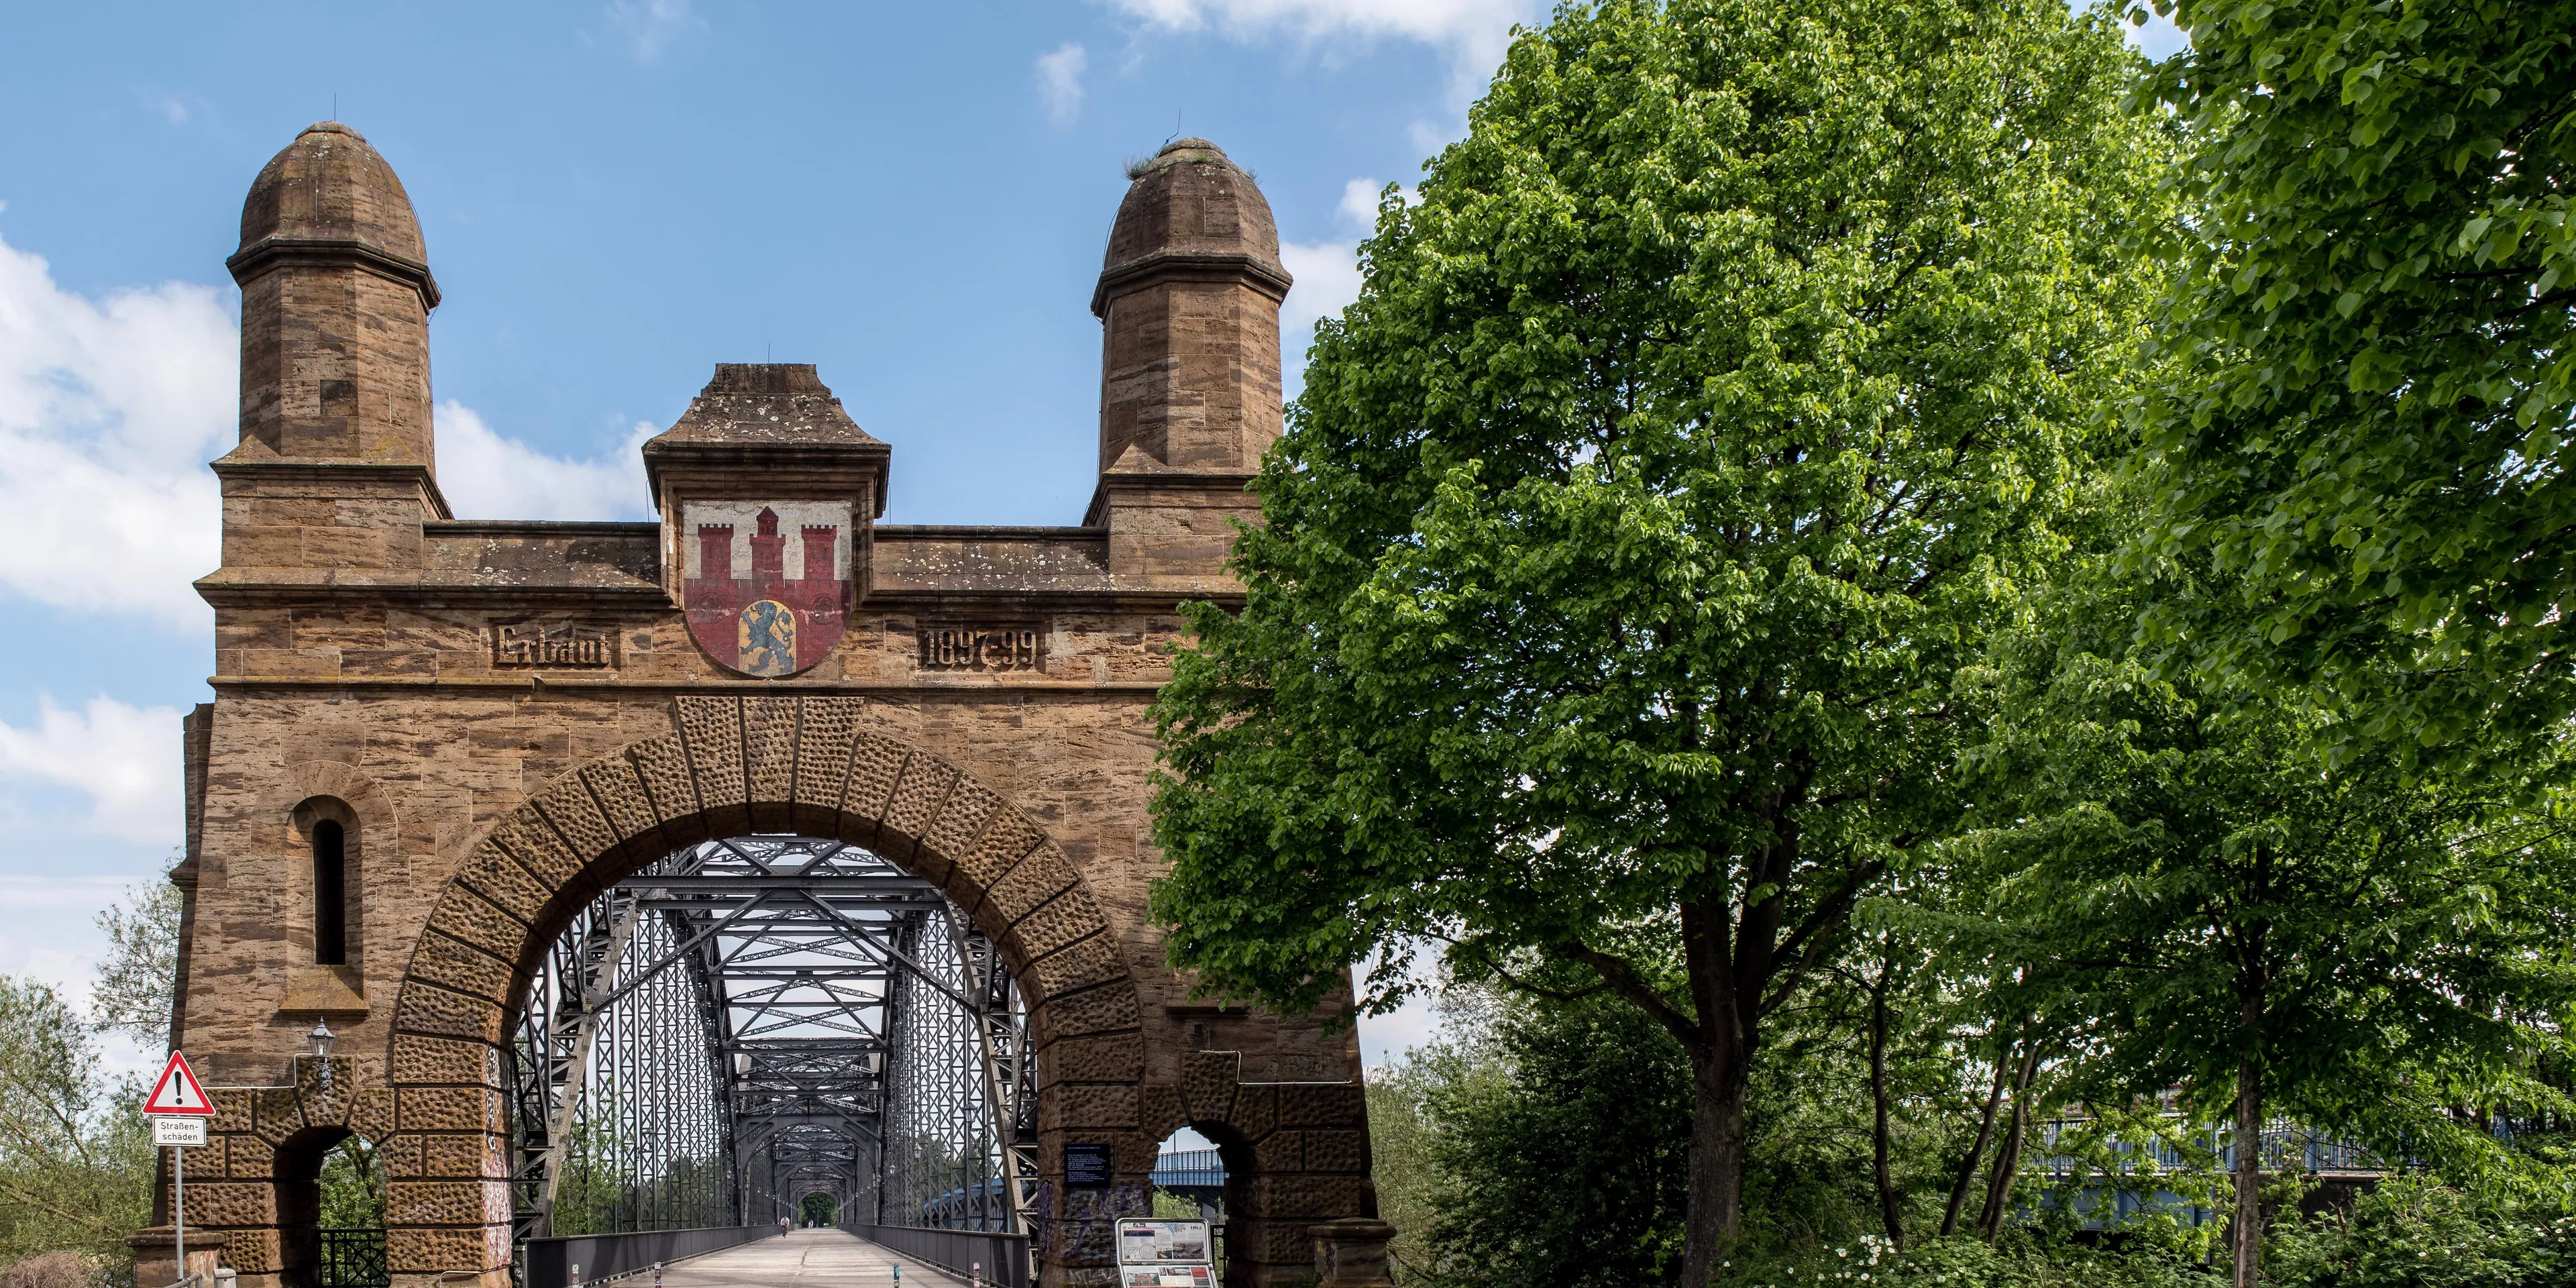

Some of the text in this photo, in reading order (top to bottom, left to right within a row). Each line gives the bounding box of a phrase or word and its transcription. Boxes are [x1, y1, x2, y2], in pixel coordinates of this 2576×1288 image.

[497, 625, 611, 664] Erbaut
[924, 630, 1036, 667] 1897-99
[160, 1122, 199, 1130] Straßen-
[162, 1132, 198, 1140] schäden
